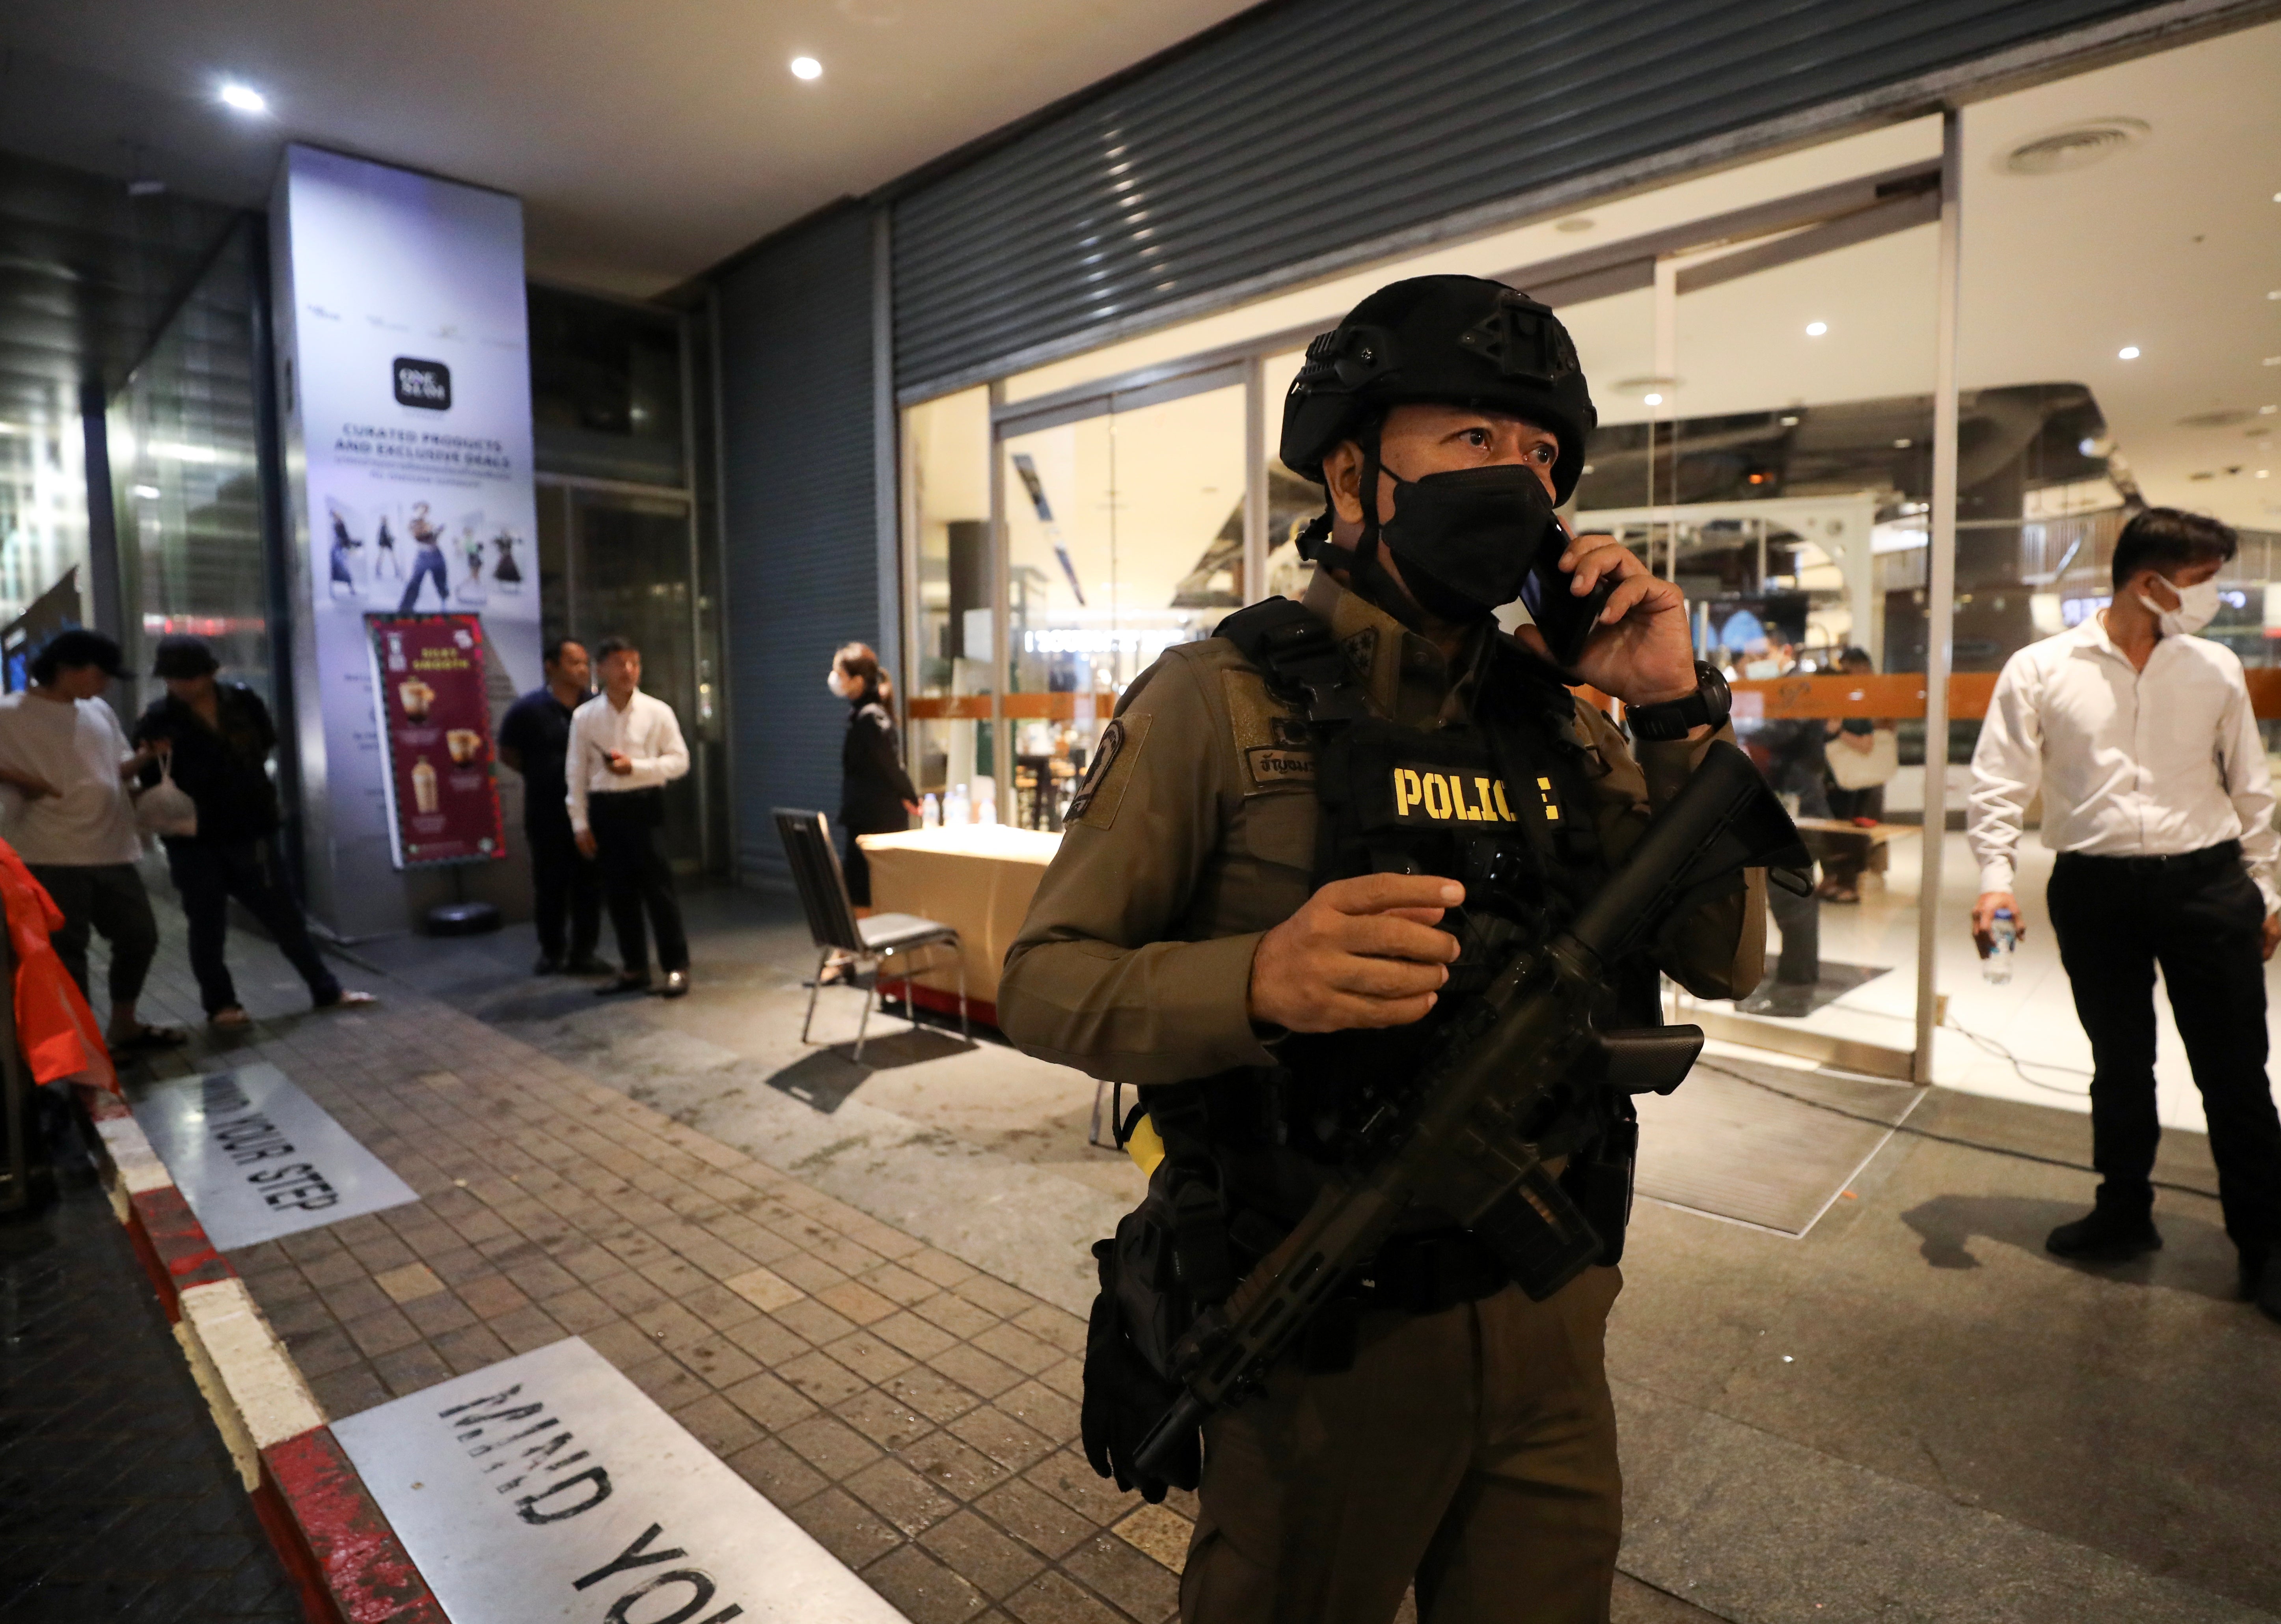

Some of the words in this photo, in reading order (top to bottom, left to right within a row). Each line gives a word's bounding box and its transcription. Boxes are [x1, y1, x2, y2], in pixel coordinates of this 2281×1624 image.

[334, 437, 371, 453] AND
[377, 444, 460, 462] EXCLUSIVE
[342, 422, 418, 443] CURATED
[422, 432, 503, 453] PRODUCTS
[210, 1111, 295, 1166] YOUR
[247, 1163, 339, 1212] STEP
